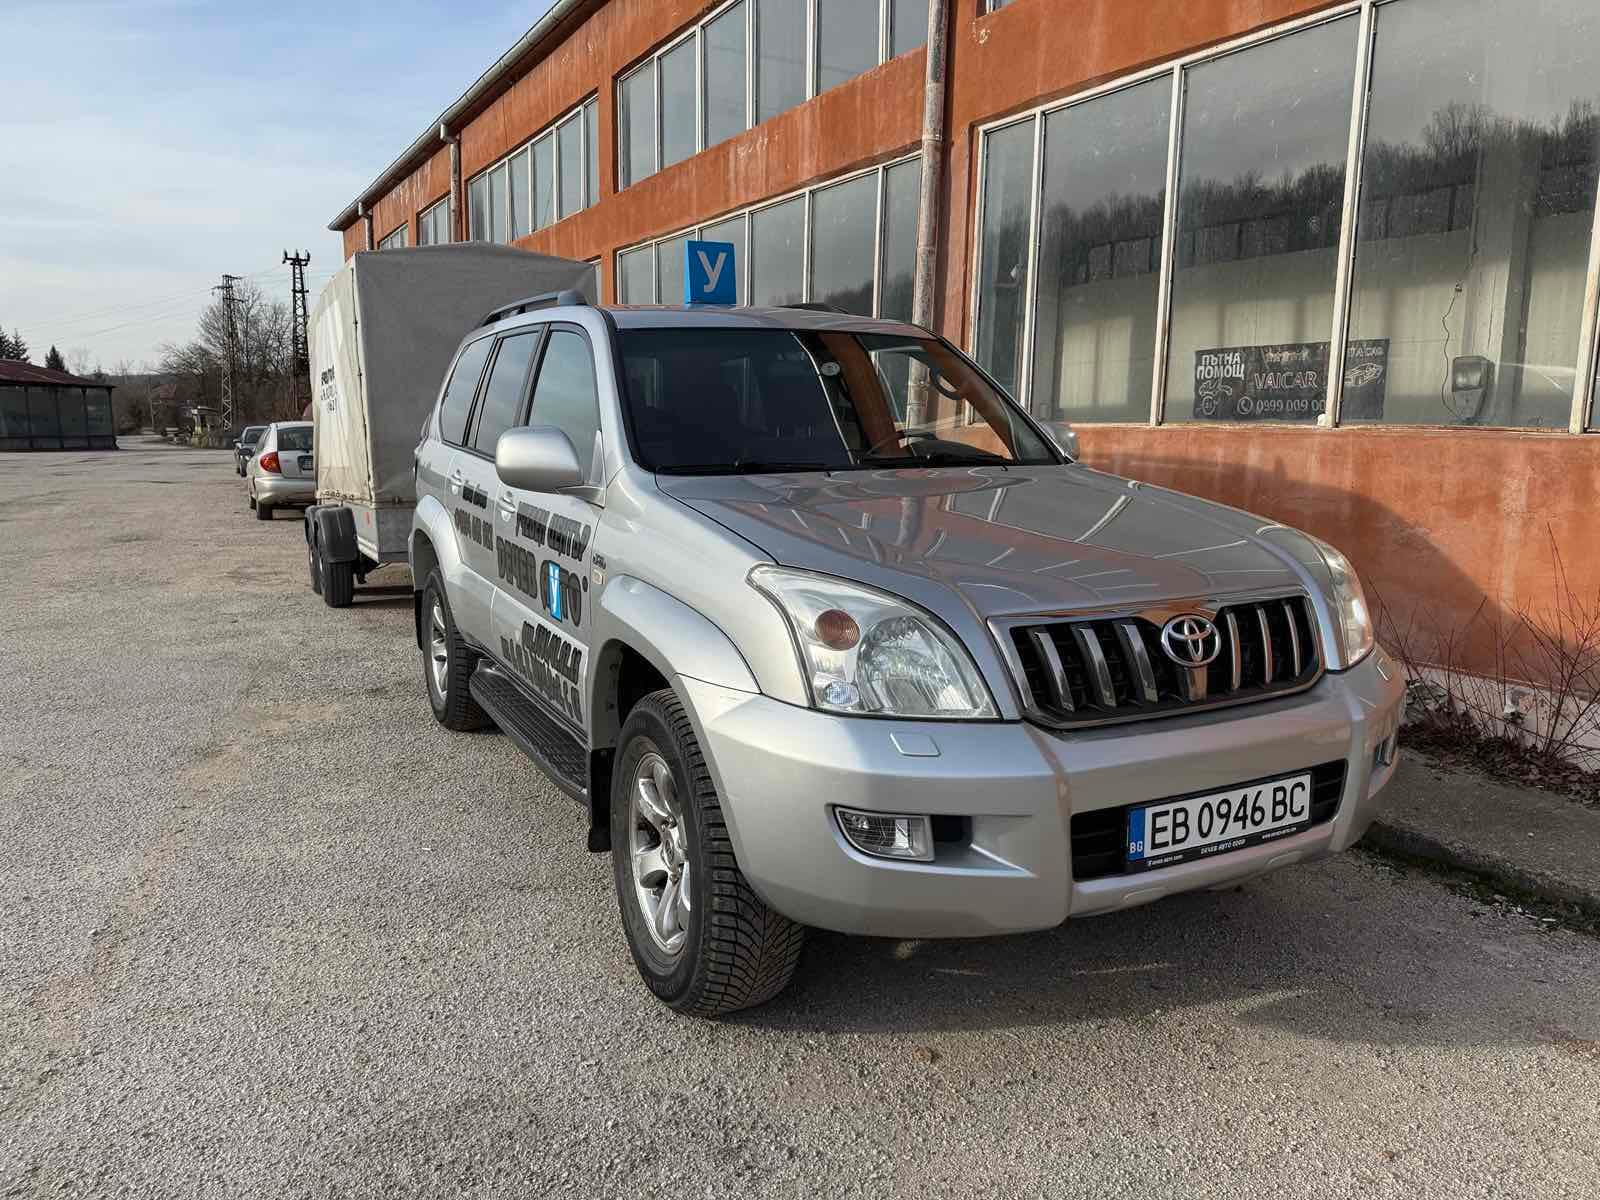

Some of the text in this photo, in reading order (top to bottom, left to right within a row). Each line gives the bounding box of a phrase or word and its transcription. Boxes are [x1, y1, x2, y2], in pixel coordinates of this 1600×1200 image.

[1197, 364, 1245, 380] ПОМОЩ
[1151, 782, 1306, 850] EB 0946 BC
[1129, 840, 1144, 854] BG
